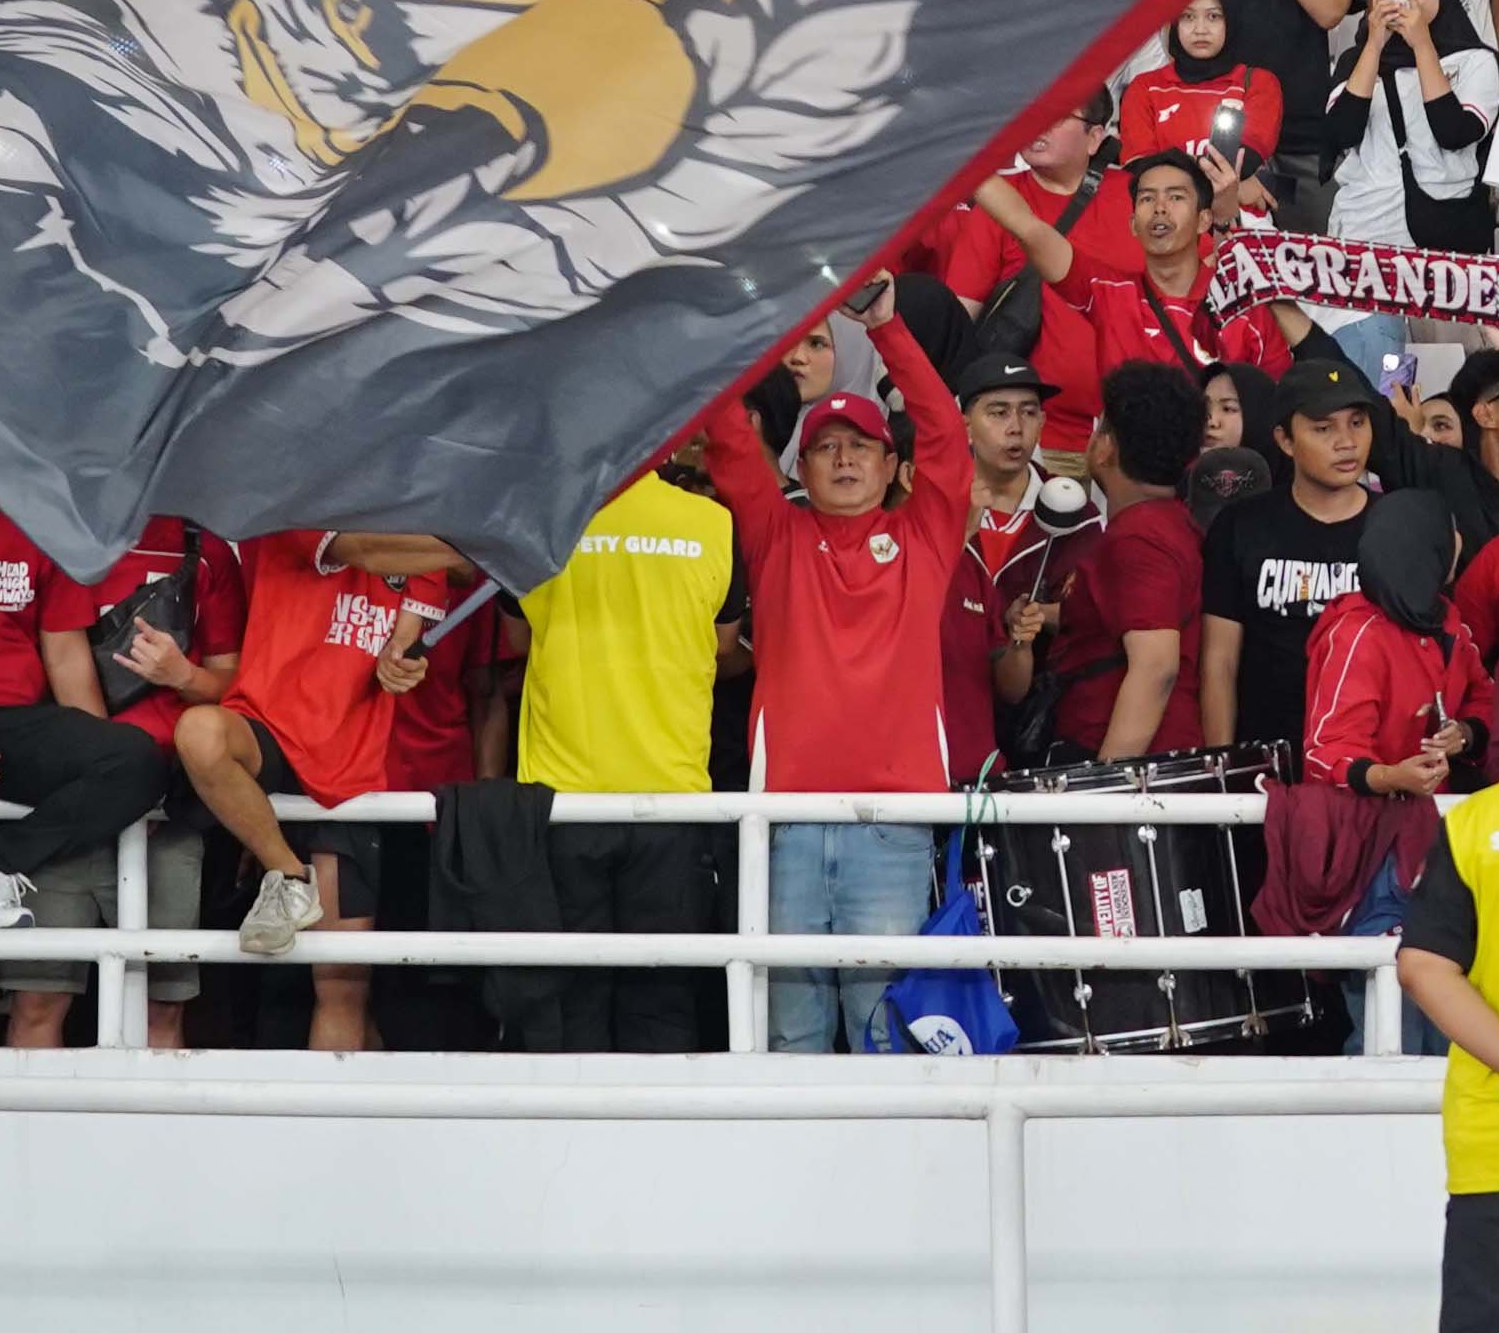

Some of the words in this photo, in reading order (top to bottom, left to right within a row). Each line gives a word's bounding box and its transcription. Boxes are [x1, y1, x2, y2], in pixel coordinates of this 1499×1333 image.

[1274, 241, 1497, 314] GRANDE
[579, 536, 621, 554] ETY
[626, 537, 702, 558] GUARD
